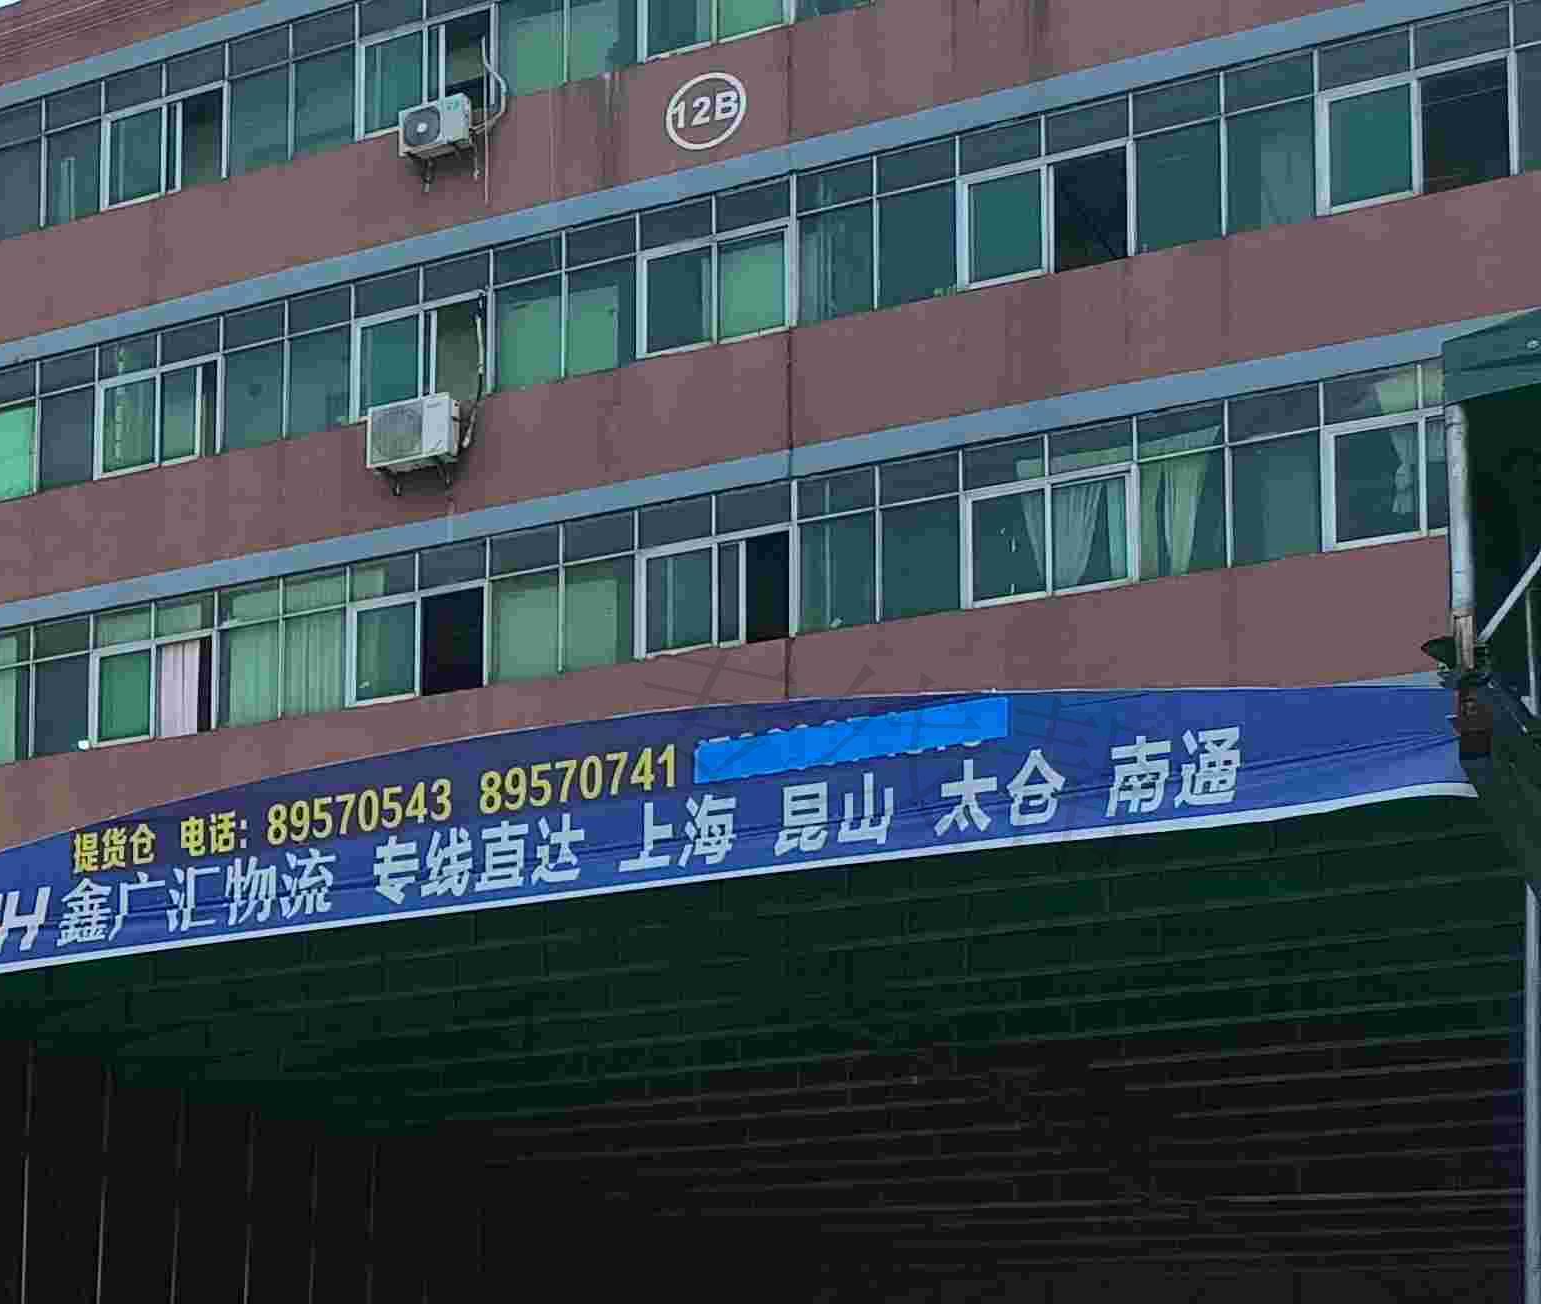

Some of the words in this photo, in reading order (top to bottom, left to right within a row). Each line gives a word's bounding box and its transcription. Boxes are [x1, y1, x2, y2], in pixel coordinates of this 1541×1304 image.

[676, 89, 739, 129] 12B
[57, 847, 337, 949] 鑫广汇物流
[371, 812, 588, 906] 专线直达
[617, 793, 738, 874] 上海
[773, 771, 896, 858] 昆山
[932, 747, 1066, 837] 太仓
[1106, 726, 1242, 819] 南通
[71, 821, 157, 876] 提货仓
[267, 778, 453, 848] 89570543
[479, 742, 678, 813] 89570741
